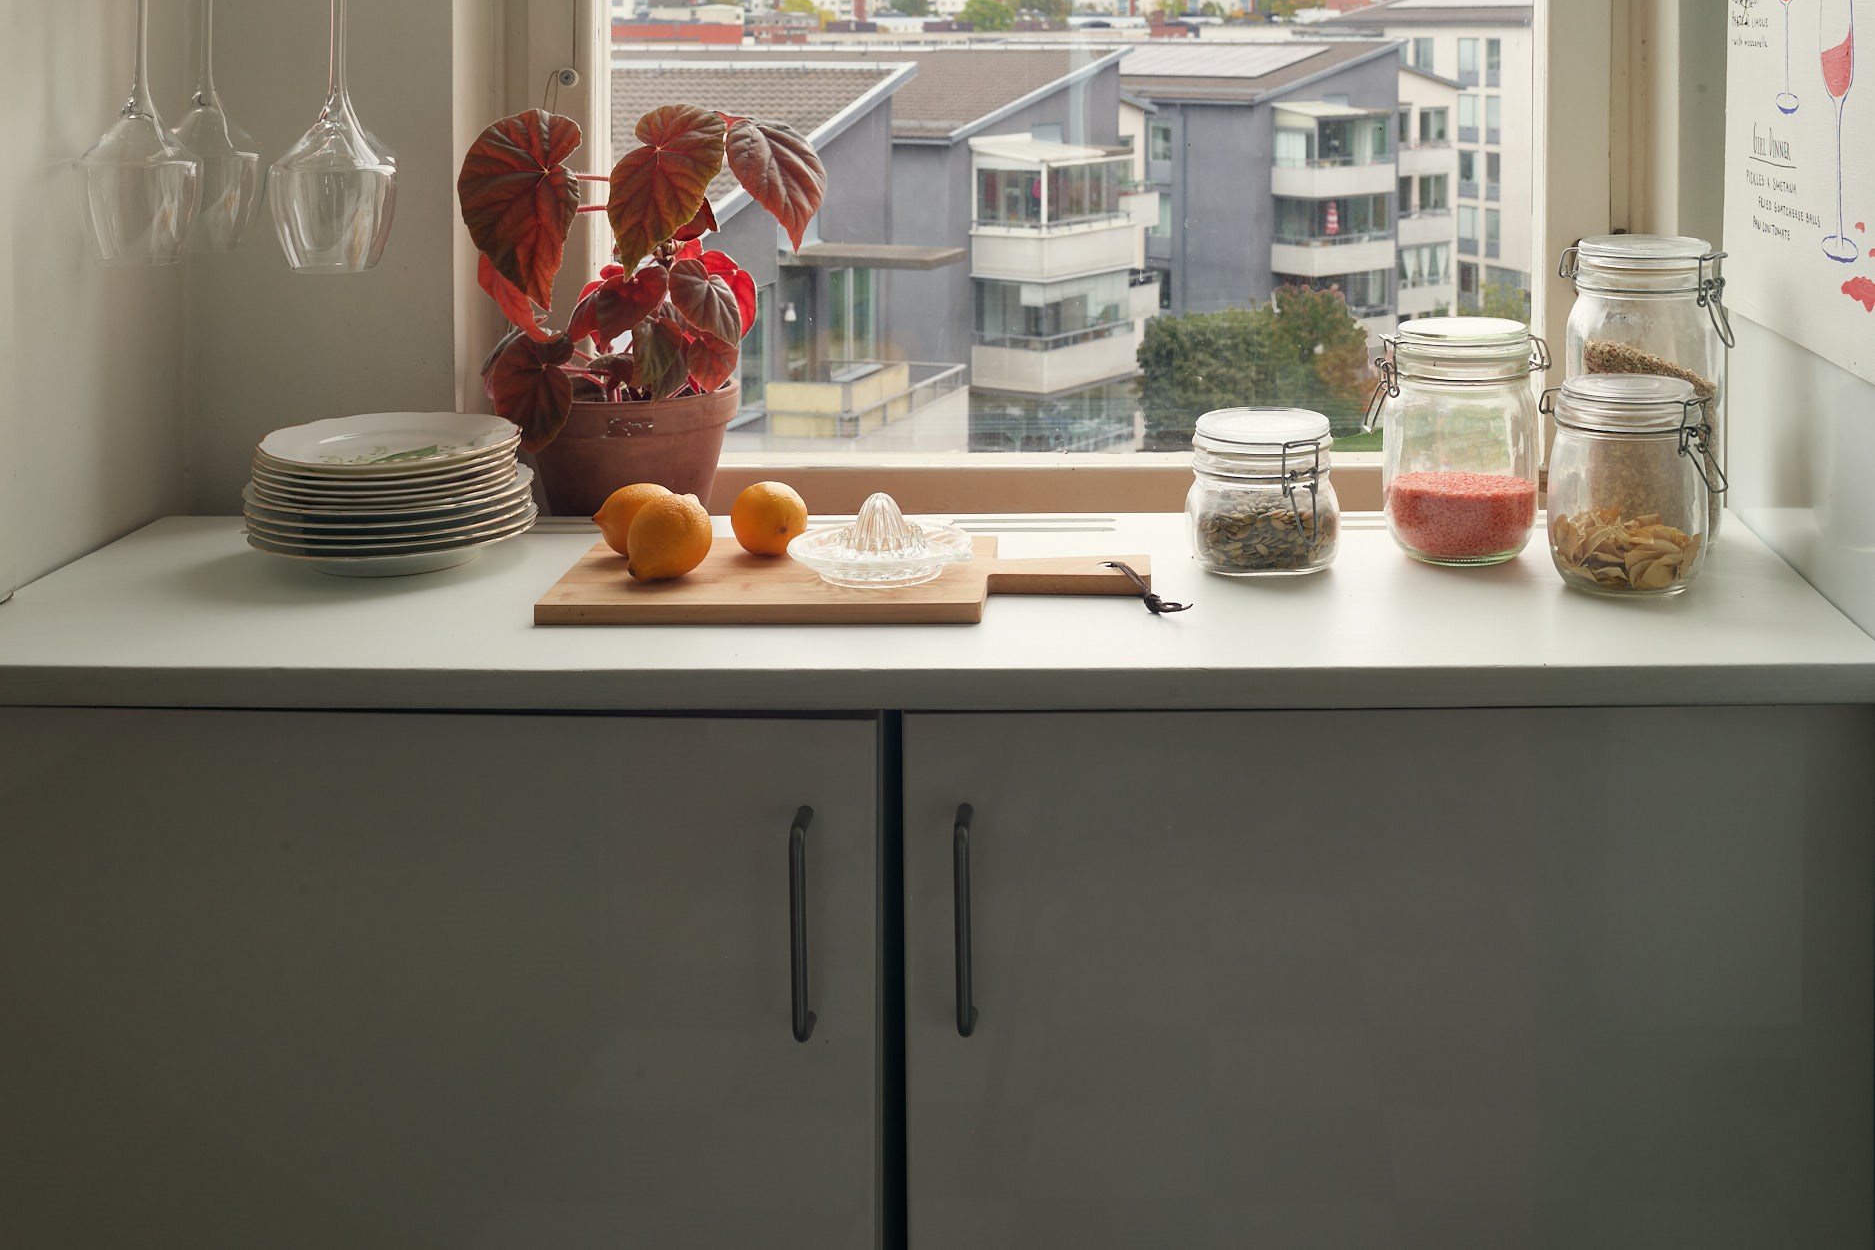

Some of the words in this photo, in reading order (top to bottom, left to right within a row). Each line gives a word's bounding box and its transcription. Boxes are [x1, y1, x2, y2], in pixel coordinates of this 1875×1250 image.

[1769, 126, 1792, 161] DINNER
[1746, 169, 1764, 186] PICKLES
[1806, 212, 1821, 228] BALLS
